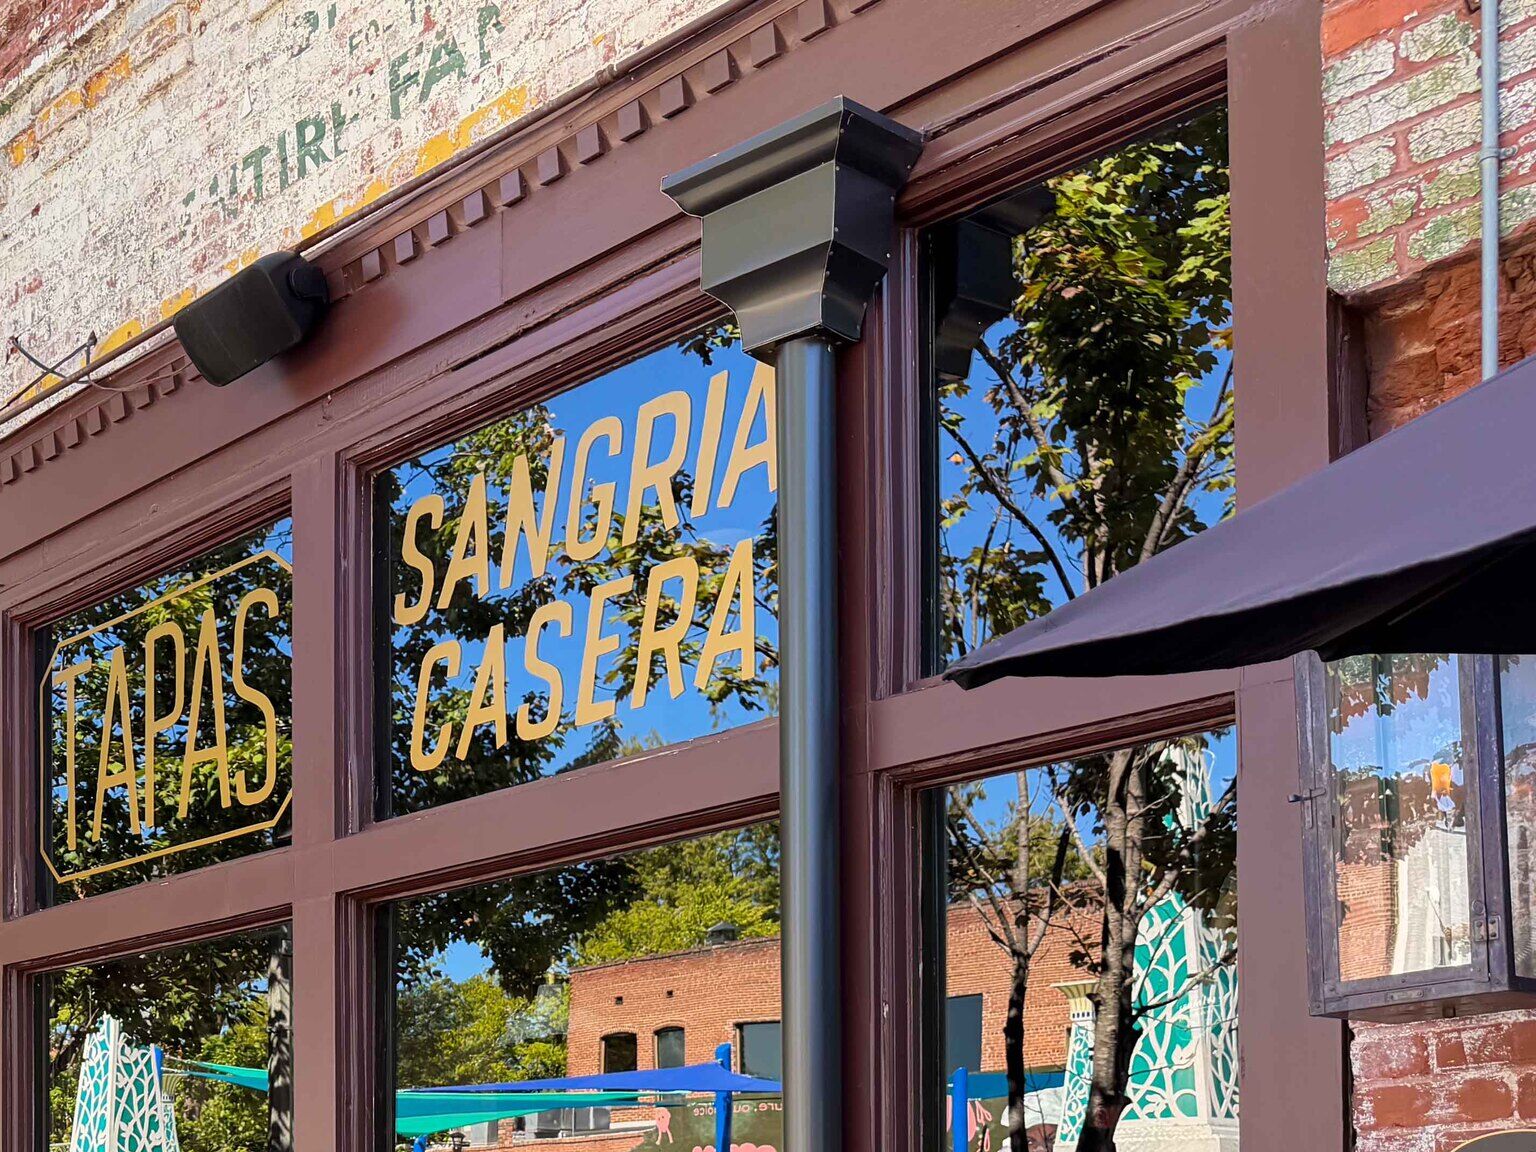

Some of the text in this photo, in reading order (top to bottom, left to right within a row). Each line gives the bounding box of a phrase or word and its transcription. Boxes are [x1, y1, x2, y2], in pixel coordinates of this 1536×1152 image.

[393, 360, 778, 626] SANGRIA
[51, 588, 279, 850] TAPAS
[409, 538, 757, 773] CASERA
